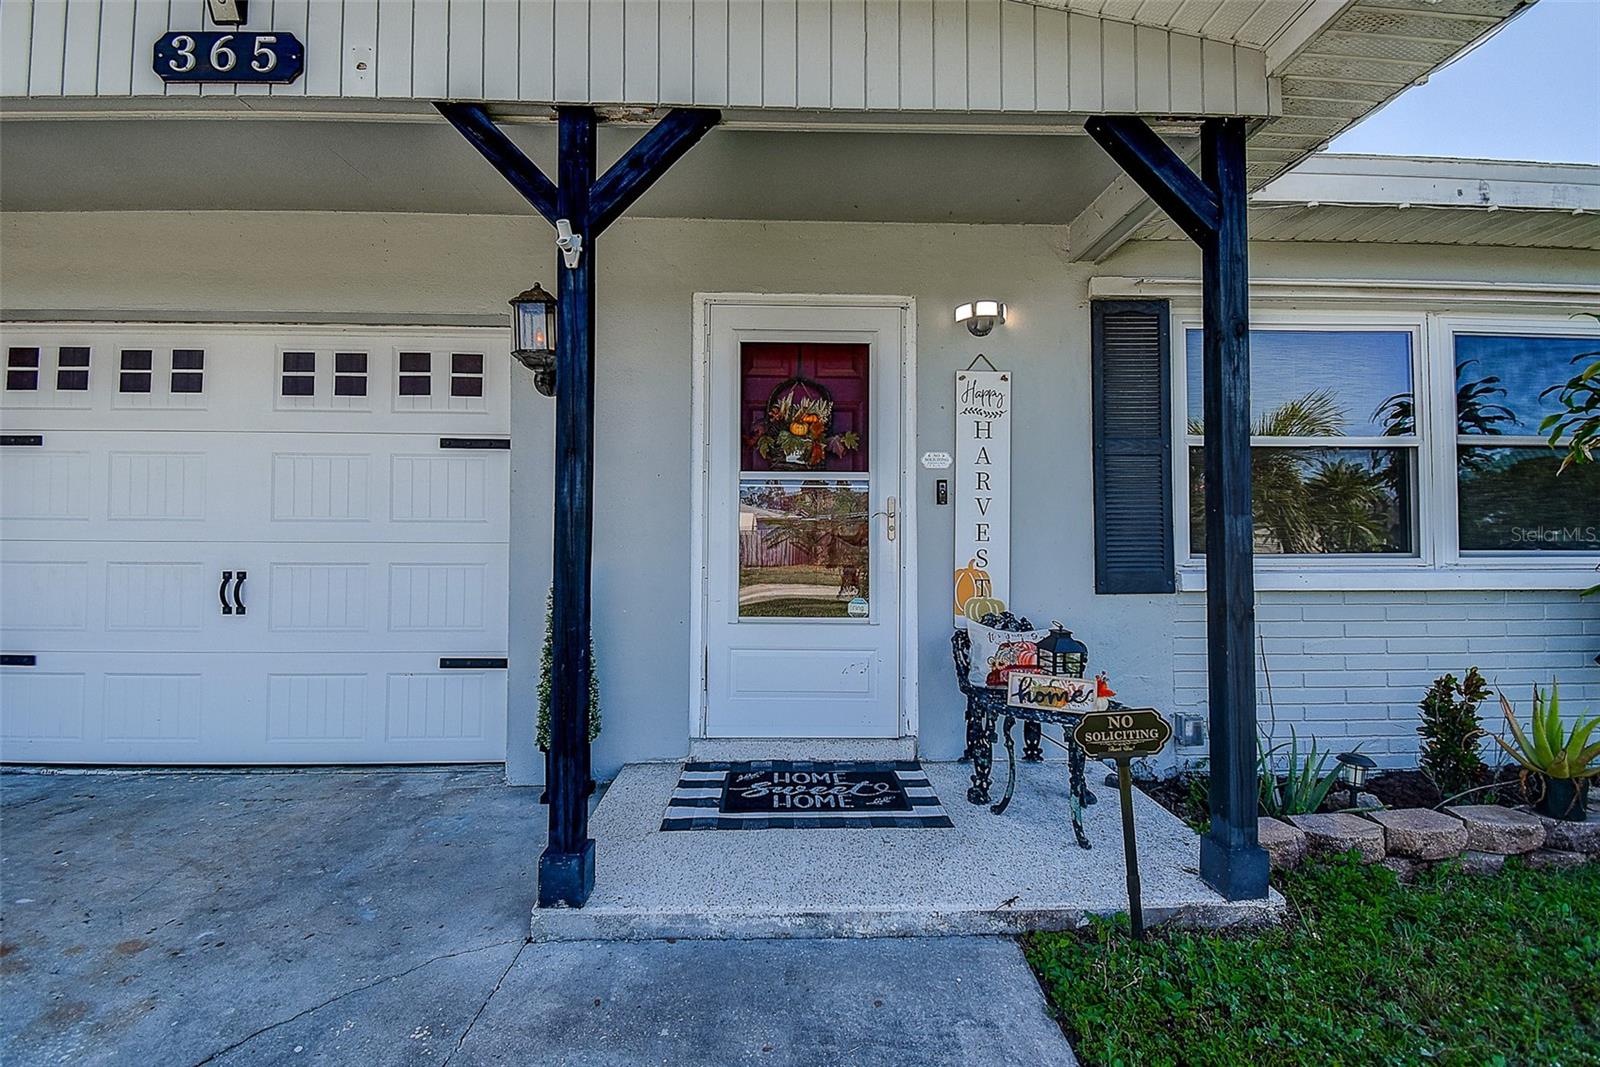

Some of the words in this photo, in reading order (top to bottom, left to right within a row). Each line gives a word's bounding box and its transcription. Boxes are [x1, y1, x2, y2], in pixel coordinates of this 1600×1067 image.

[169, 35, 277, 73] 365
[961, 380, 1005, 407] Happy
[973, 420, 993, 598] HARVEST
[1011, 676, 1094, 704] home
[1107, 715, 1134, 729] NO
[1084, 728, 1159, 742] SOLICITING
[773, 772, 848, 784] HOME
[736, 781, 892, 798] Sweet
[773, 794, 855, 808] HOME
